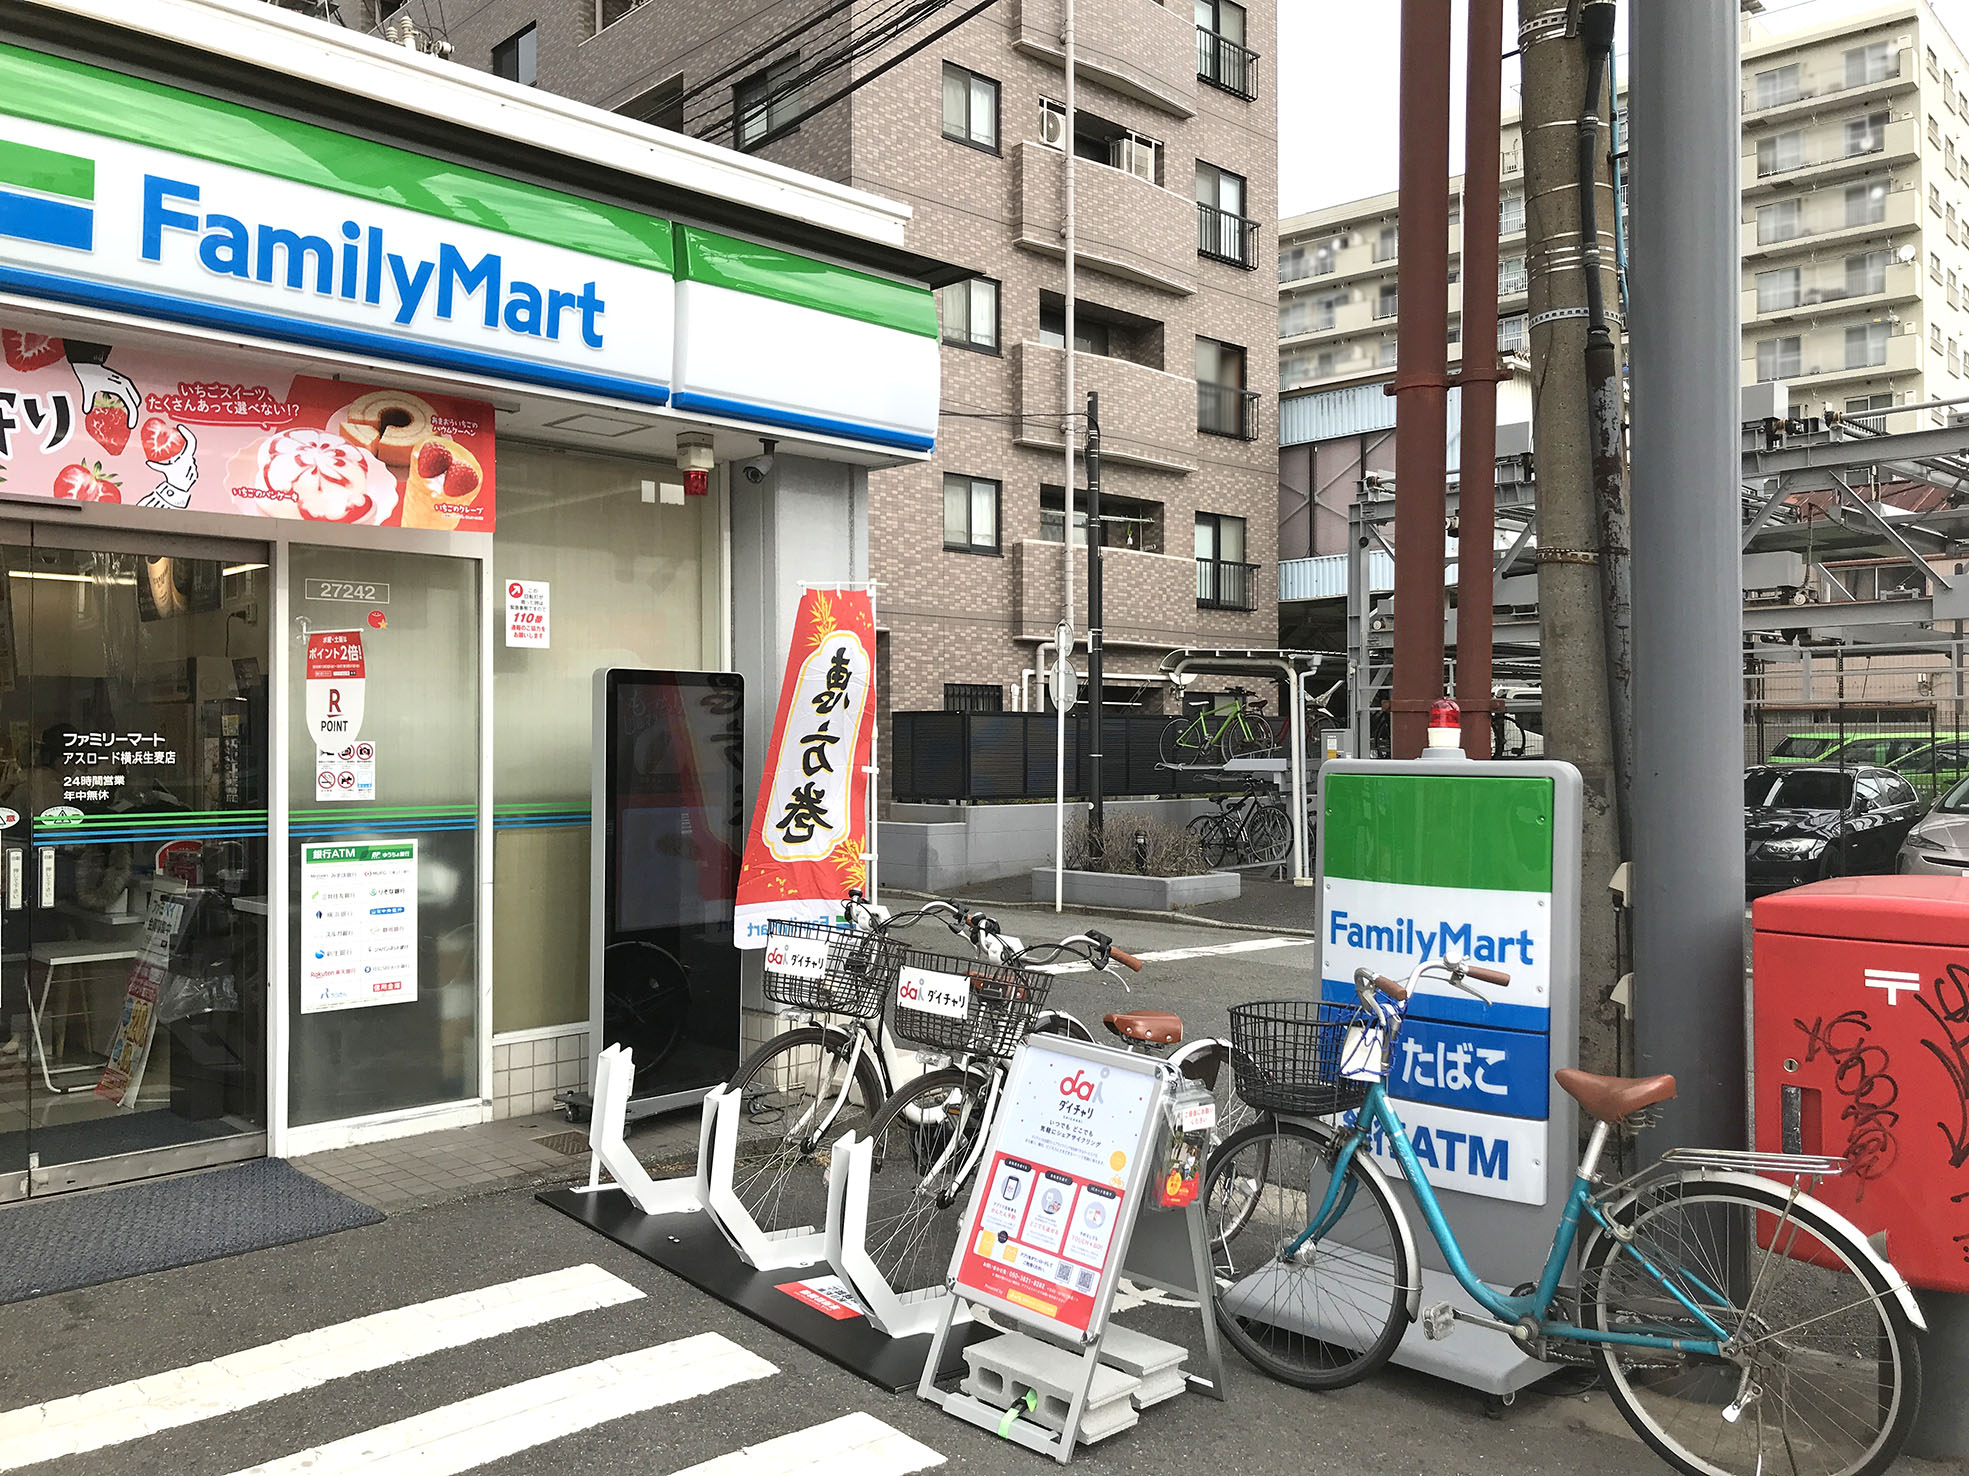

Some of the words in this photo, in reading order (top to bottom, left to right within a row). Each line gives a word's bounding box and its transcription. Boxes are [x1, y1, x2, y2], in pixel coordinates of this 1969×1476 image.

[140, 174, 606, 349] FamilyMart
[320, 583, 376, 600] 27242
[329, 688, 342, 713] R
[320, 720, 349, 733] POINT
[63, 732, 166, 747] ファミリーマート
[63, 751, 176, 765] アスロード横浜生麦店
[63, 775, 125, 788] 24時間営業
[63, 790, 110, 802] 年中無休
[312, 848, 356, 859] 銀行ATM
[1330, 910, 1534, 966] FamilyMart
[790, 954, 824, 970] ダイチャリ
[927, 990, 966, 1009] ダイチャリ
[1401, 1037, 1508, 1096] たばこ
[1059, 1100, 1094, 1119] ダイチャリ
